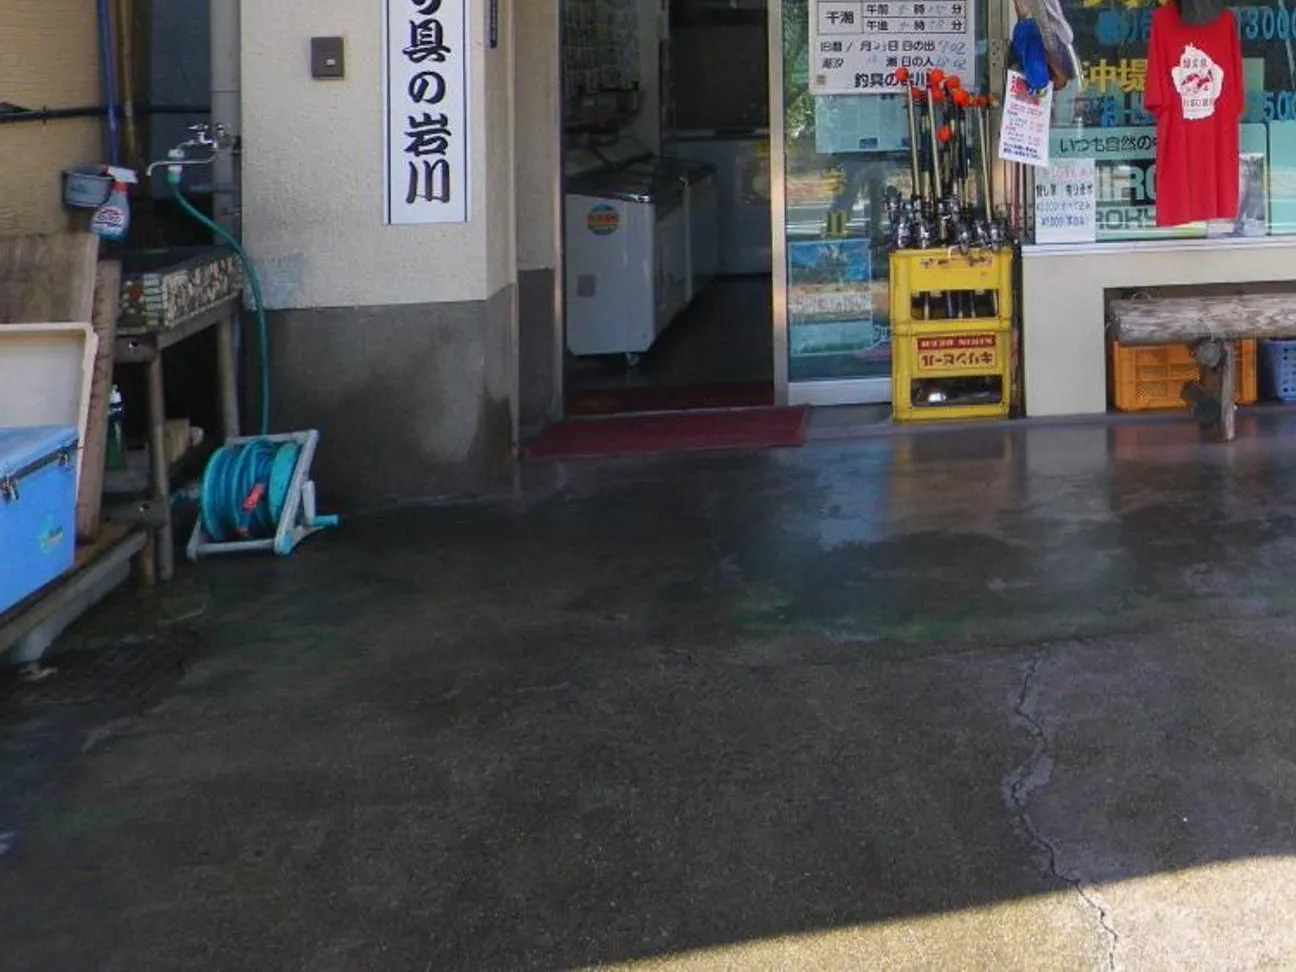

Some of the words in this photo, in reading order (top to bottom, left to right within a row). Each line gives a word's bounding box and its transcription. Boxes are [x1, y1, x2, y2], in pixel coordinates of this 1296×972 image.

[921, 351, 993, 367] キリンビール
